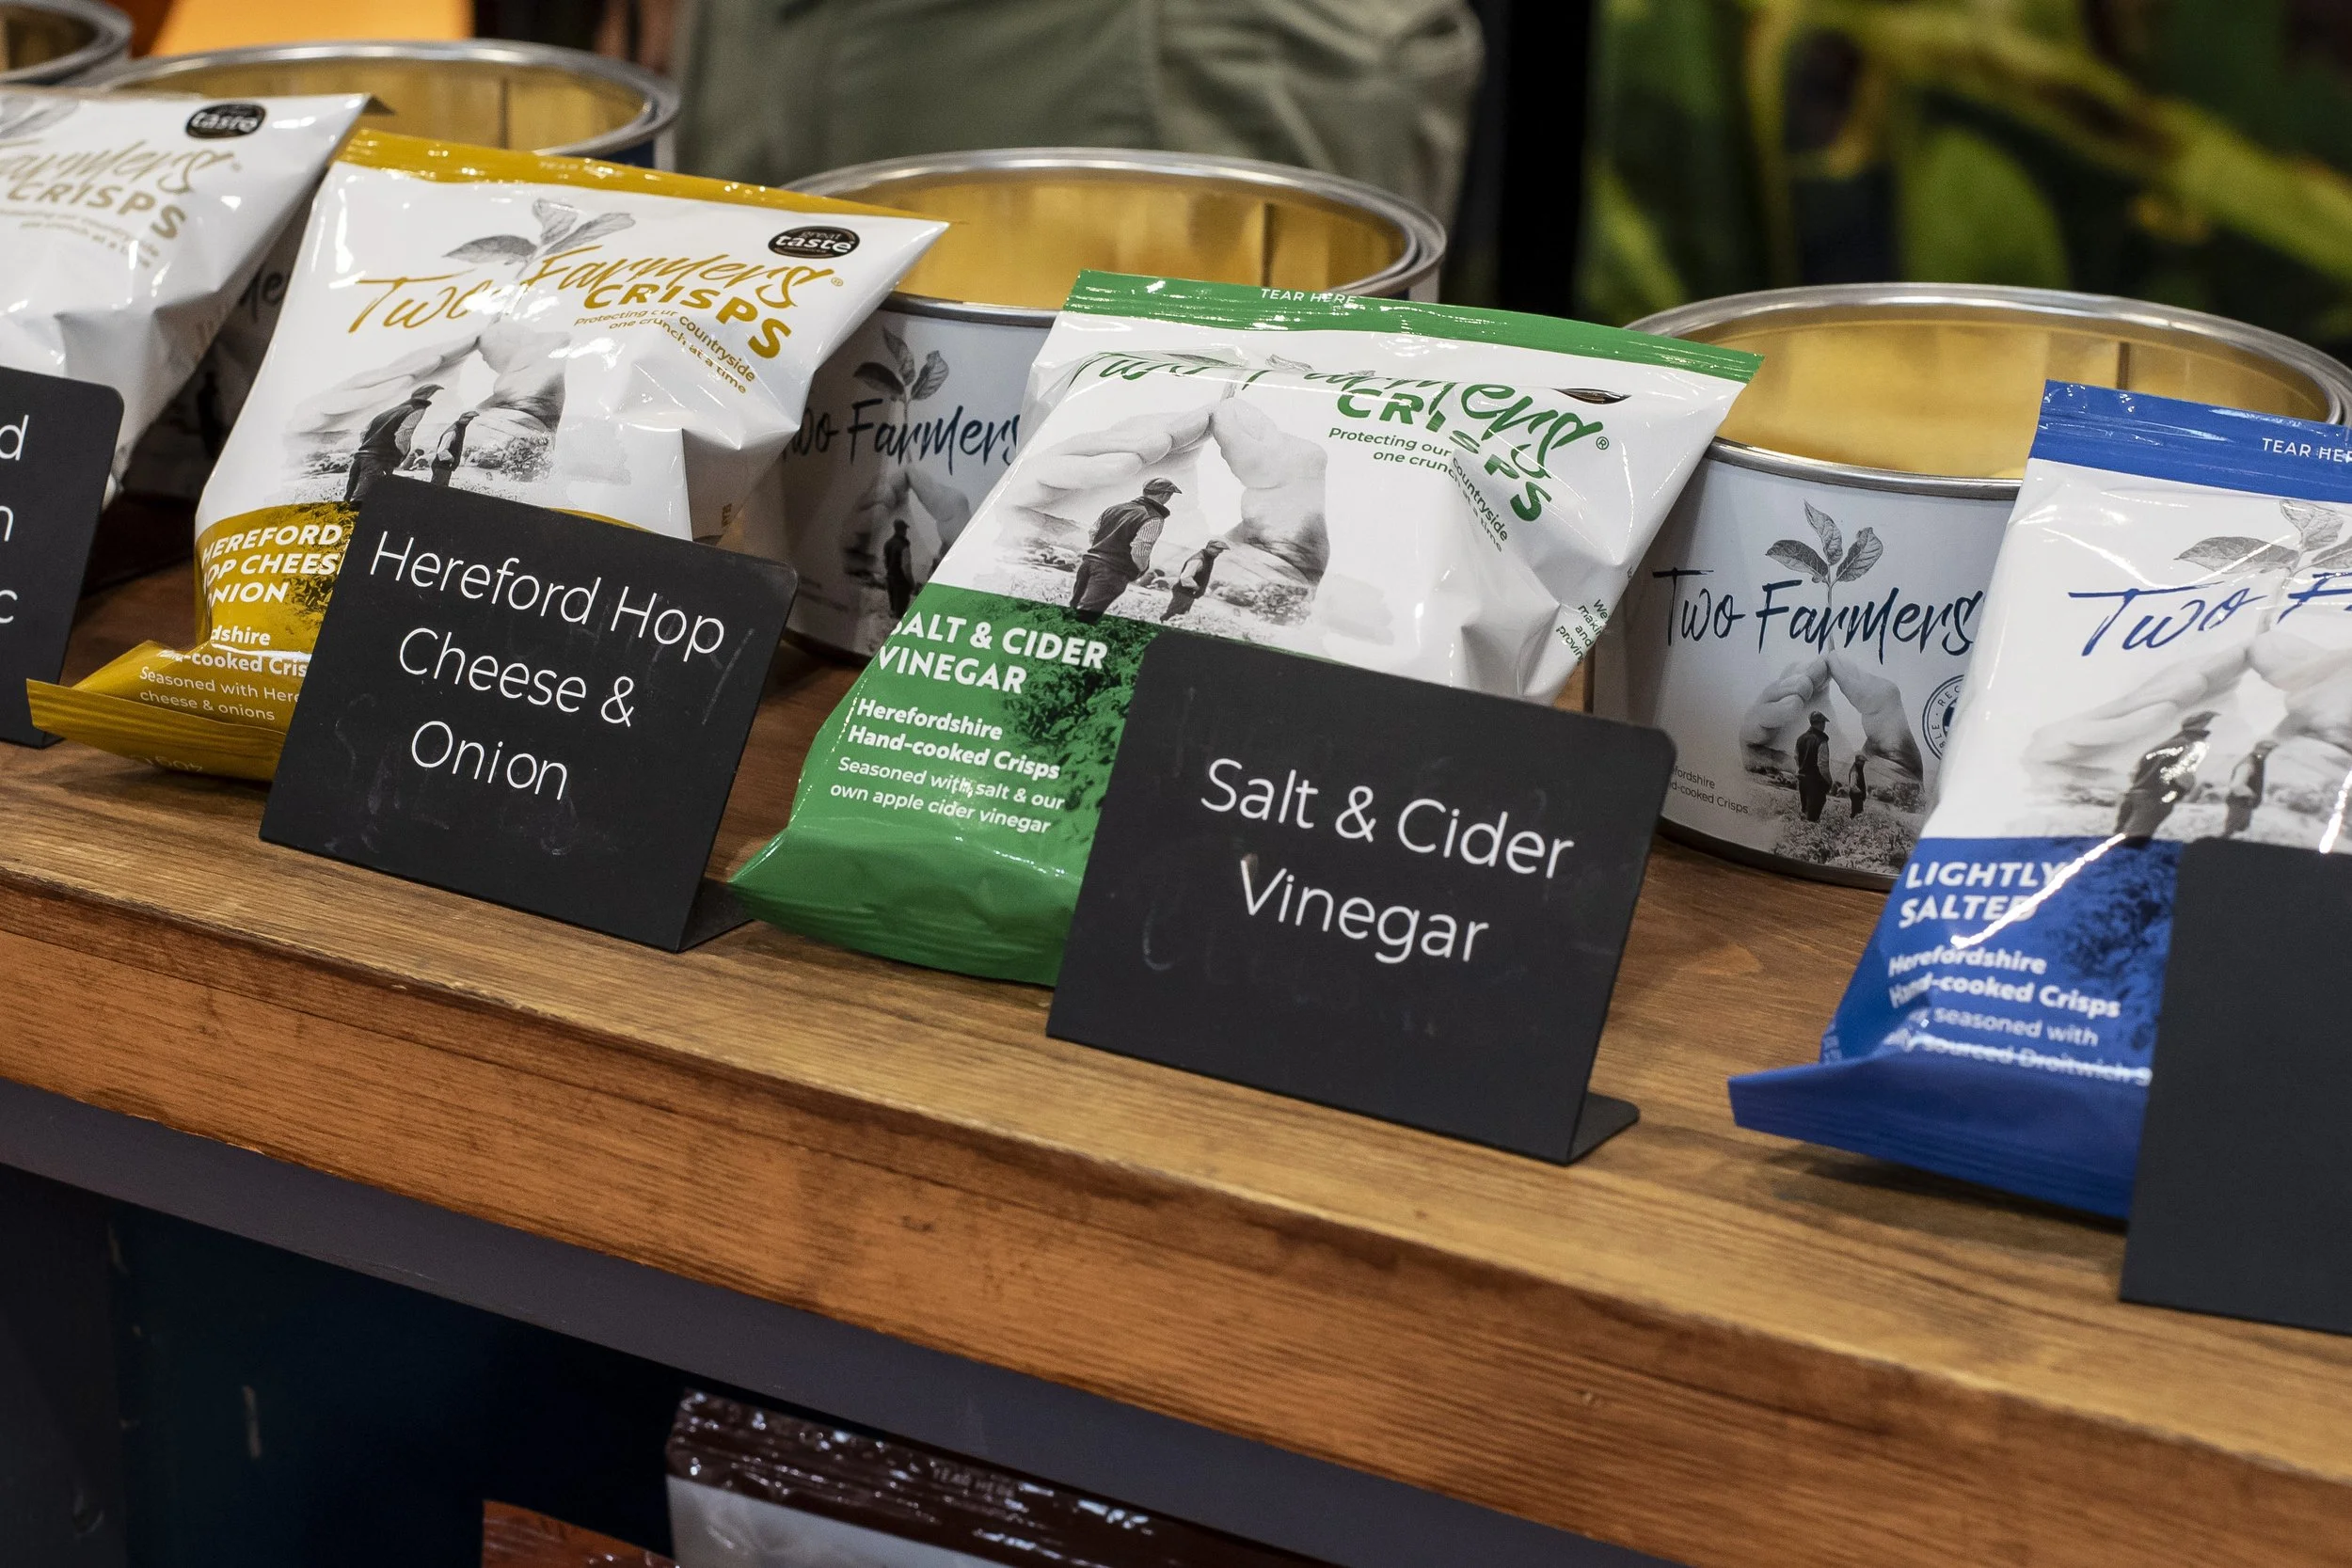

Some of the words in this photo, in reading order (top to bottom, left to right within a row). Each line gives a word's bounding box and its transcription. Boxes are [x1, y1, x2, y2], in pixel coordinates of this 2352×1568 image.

[774, 234, 852, 254] taste
[582, 282, 793, 360] CRISPS
[1261, 288, 1305, 302] TEAR
[1310, 292, 1358, 304] HERE
[573, 309, 648, 326] Protecting
[678, 315, 756, 382] countryside
[609, 320, 637, 330] one
[639, 317, 687, 346] crunch
[688, 344, 704, 359] at
[705, 356, 714, 368] a
[715, 367, 747, 395] time
[1336, 388, 1553, 522] CRISPS
[1373, 450, 1406, 463] one
[2262, 436, 2312, 458] TEAR
[1328, 426, 1418, 451] Protecting
[1422, 442, 1453, 457] our
[1452, 457, 1509, 543] countryside
[200, 523, 343, 570] HEREFORD
[240, 538, 351, 576] CHEES
[370, 530, 603, 626] Hereford
[610, 585, 725, 663] Hop
[1652, 566, 1745, 647] Two
[1756, 578, 1985, 666] Farmers
[2068, 580, 2268, 657] Two
[969, 621, 993, 651] &
[1002, 626, 1108, 671] CIDER
[1574, 625, 1595, 648] and
[138, 665, 216, 693] Seasoned
[219, 682, 259, 699] with
[398, 626, 587, 714] Cheese
[600, 675, 636, 728] &
[878, 645, 1027, 695] VINEGAR
[139, 689, 198, 709] cheese
[202, 699, 215, 712] &
[218, 703, 276, 721] onions
[856, 697, 1003, 741] Herefordshire
[410, 720, 568, 801] Onion
[847, 724, 991, 767] Hand-cooked
[993, 750, 1061, 781] Crisps
[830, 783, 869, 801] own
[872, 787, 925, 811] apple
[928, 798, 977, 820] cider
[978, 807, 1052, 834] vinegar
[837, 756, 928, 785] Seasoned
[930, 772, 972, 795] with
[975, 783, 1010, 800] salt
[1012, 786, 1027, 803] &
[1030, 793, 1065, 811] our
[1716, 796, 1749, 815] Crisps
[1200, 757, 1319, 830] Salt
[1334, 784, 1377, 843] &
[1397, 798, 1575, 879] Cider
[1905, 861, 2070, 890] LIGHTLY
[1240, 855, 1490, 964] Vinegar
[1887, 943, 2048, 978] Herefordshire
[1932, 1006, 2043, 1039] seasoned
[2045, 1024, 2099, 1048] with
[2038, 984, 2122, 1021] Crisps
